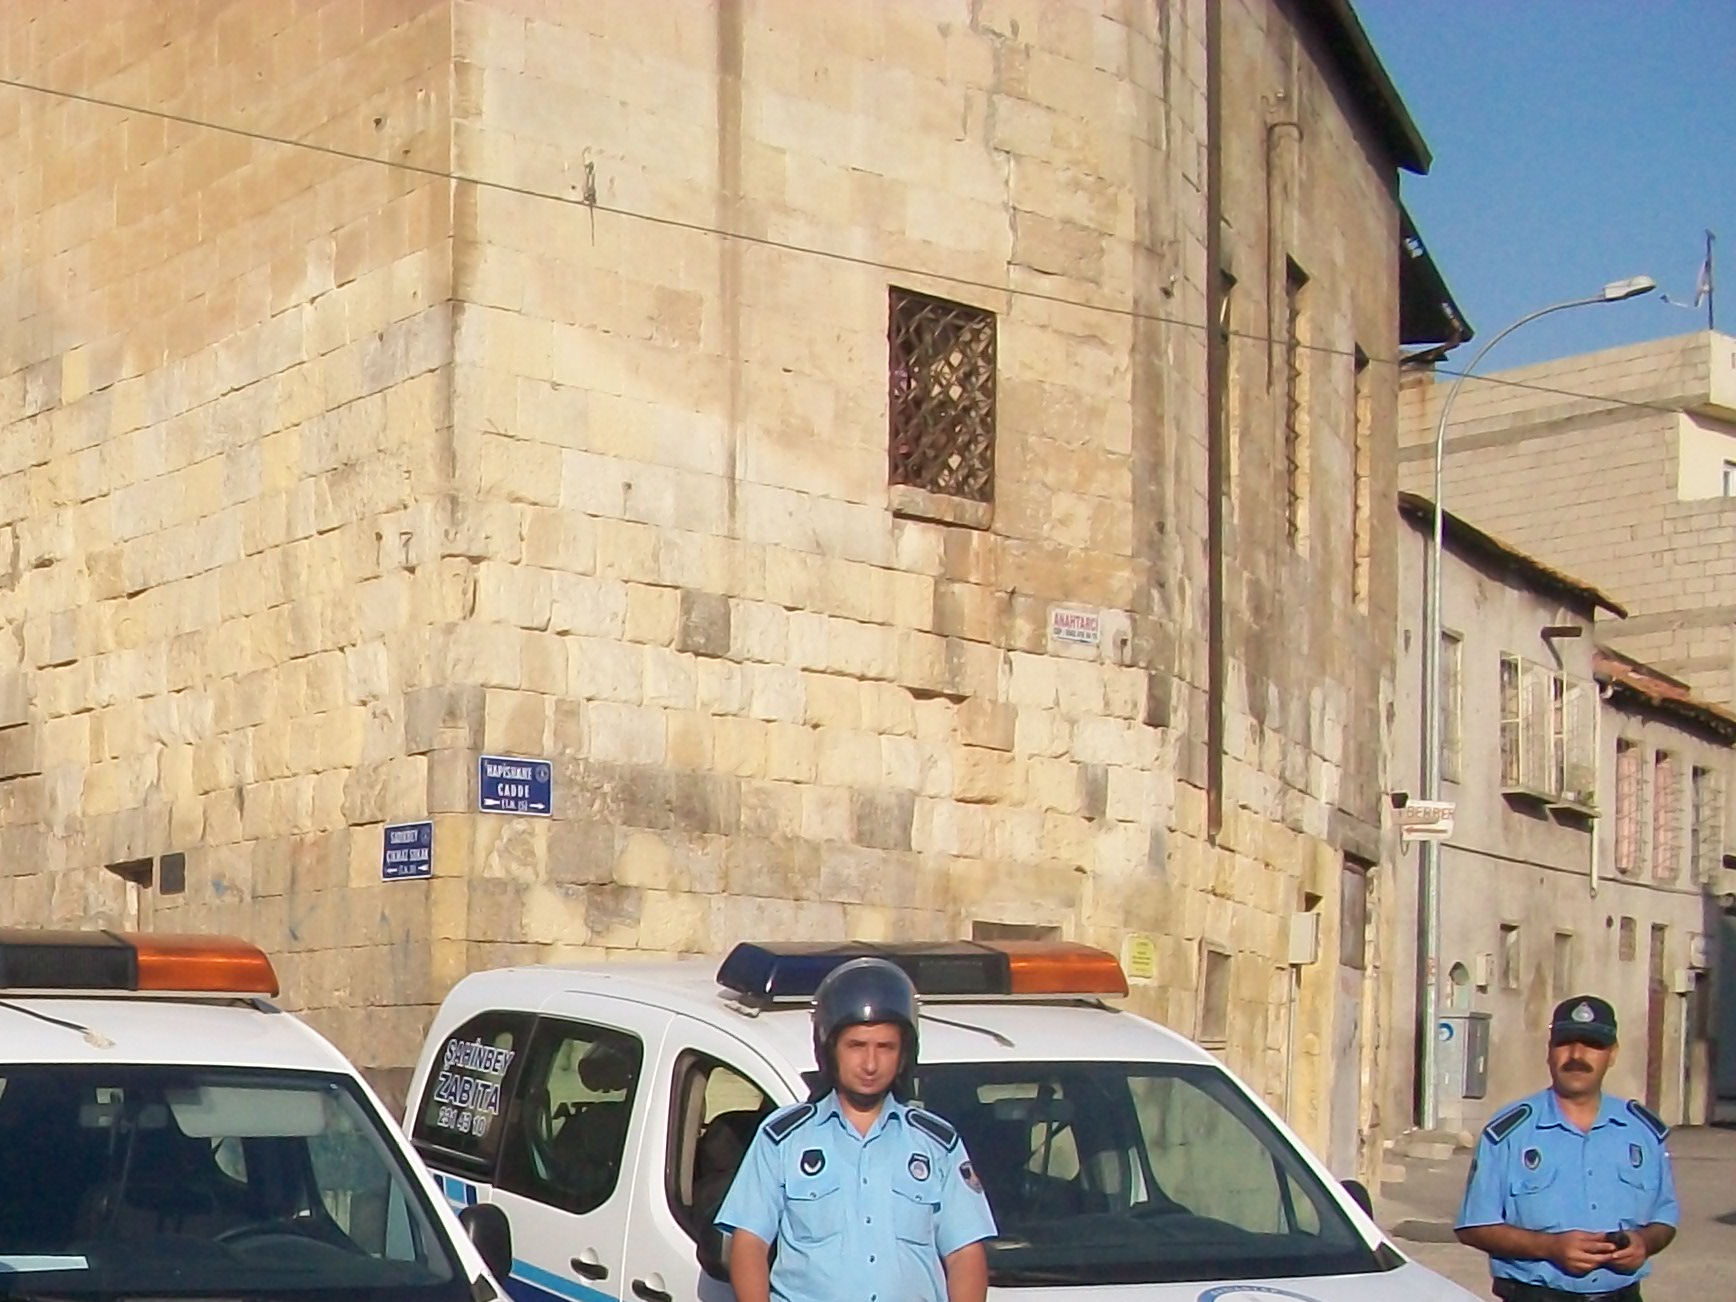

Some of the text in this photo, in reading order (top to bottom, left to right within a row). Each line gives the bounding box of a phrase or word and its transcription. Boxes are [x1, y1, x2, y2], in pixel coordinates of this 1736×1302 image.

[497, 783, 530, 798] CADDE
[444, 1037, 515, 1076] ŞAHİNBEY
[434, 1071, 501, 1116] ZABITA
